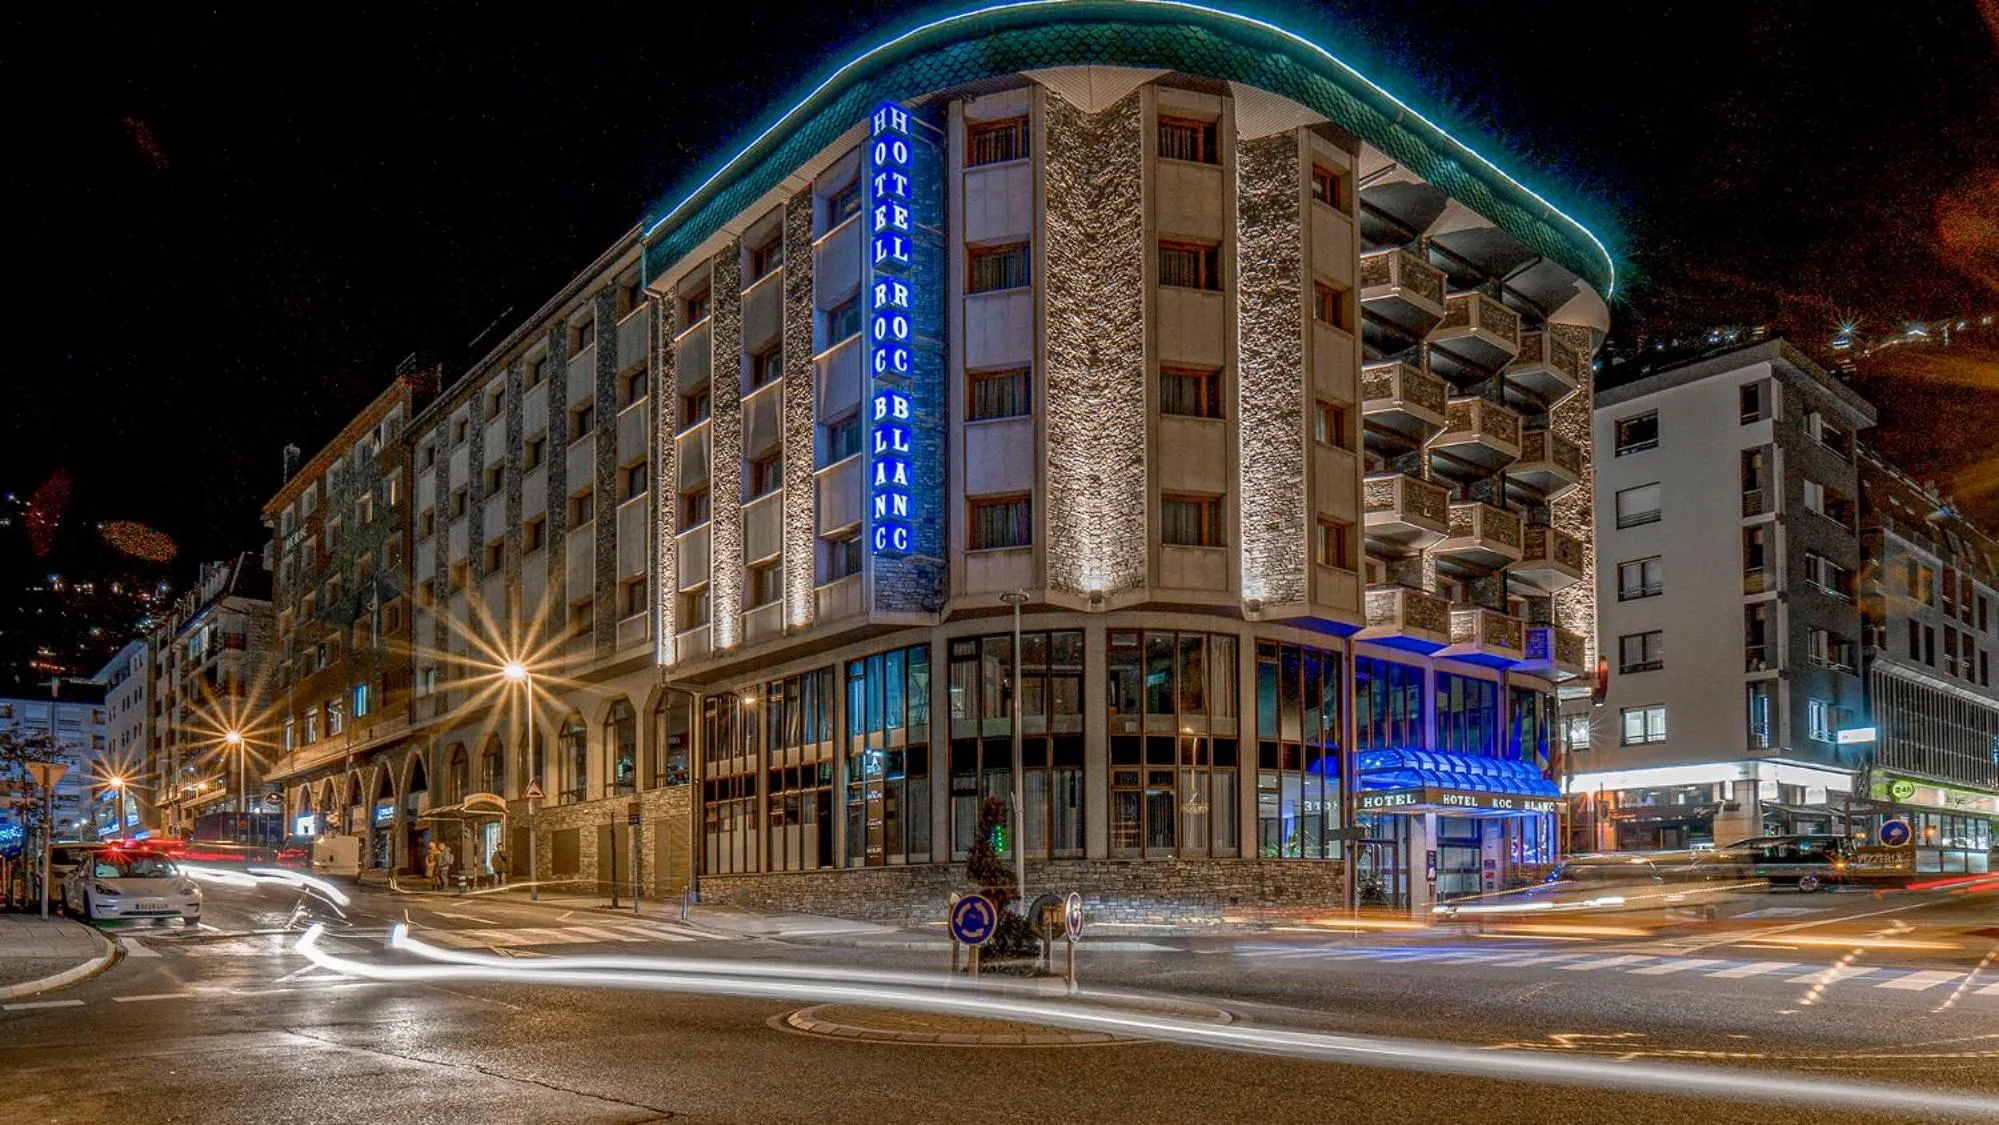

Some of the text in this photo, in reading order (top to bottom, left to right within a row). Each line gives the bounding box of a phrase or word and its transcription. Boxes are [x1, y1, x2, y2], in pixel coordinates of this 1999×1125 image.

[873, 108, 887, 550] HOTEL ROC BLANC
[890, 106, 909, 550] HOTEL ROC BLANC
[1364, 794, 1416, 808] HOTEL
[1443, 794, 1555, 812] HOTEL ROC BLANC
